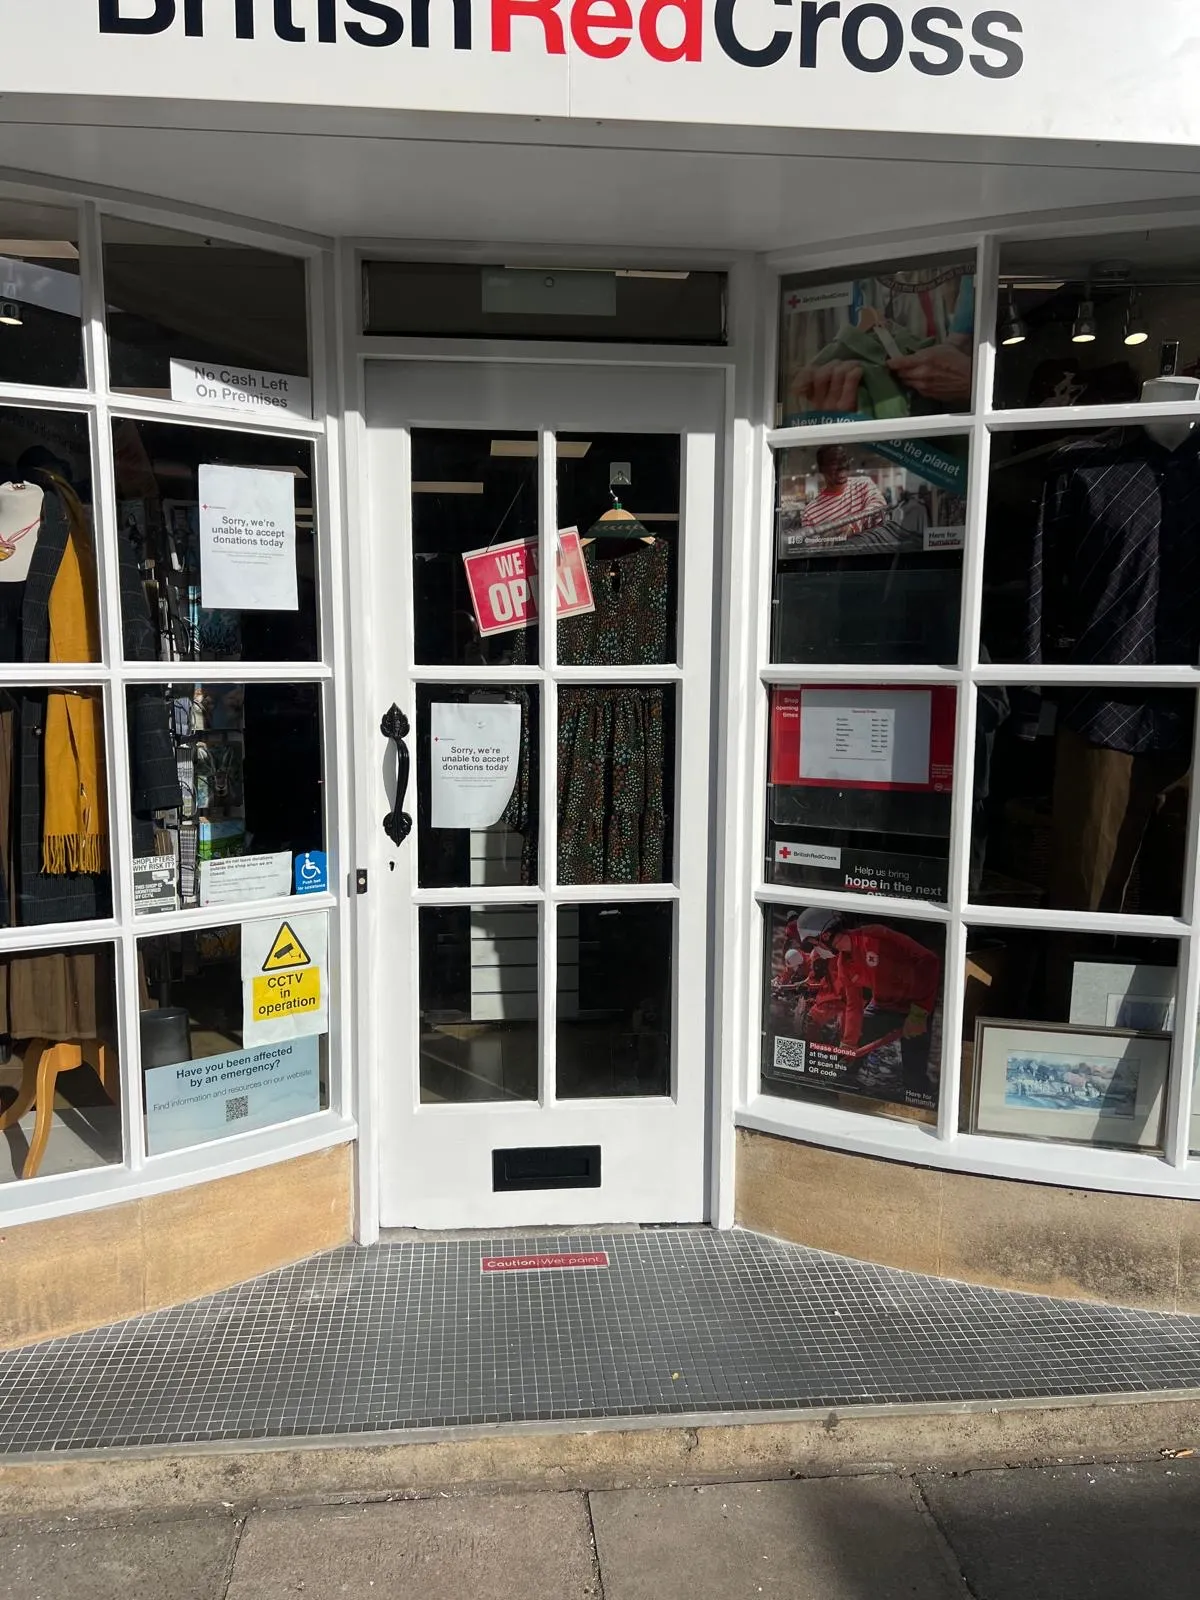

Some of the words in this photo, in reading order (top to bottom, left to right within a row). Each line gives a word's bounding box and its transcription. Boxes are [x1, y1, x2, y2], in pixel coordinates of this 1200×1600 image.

[194, 366, 215, 381] No
[220, 371, 256, 387] Cash
[262, 376, 288, 391] Left
[196, 384, 217, 398] On
[222, 387, 288, 408] Premises
[791, 417, 817, 428] New
[821, 416, 833, 424] to
[903, 442, 922, 458] the
[922, 454, 960, 477] planet
[222, 516, 249, 527] Sorry,
[251, 519, 275, 527] we're
[212, 526, 242, 535] unable
[256, 530, 285, 539] accept
[213, 536, 258, 545] donations
[260, 539, 284, 548] today
[495, 547, 538, 579] WE'
[451, 746, 476, 755] Sorry,
[482, 756, 509, 764] accept
[443, 763, 483, 771] donations
[486, 764, 508, 772] today
[133, 856, 174, 866] SHOPLIFTERS
[793, 851, 837, 861] BritishRedCross
[133, 864, 147, 872] WHY
[855, 866, 873, 876] Help
[876, 869, 886, 877] us
[888, 869, 909, 881] bring
[845, 875, 877, 889] hope
[880, 880, 890, 890] in
[893, 881, 911, 892] the
[916, 886, 942, 896] next
[268, 973, 303, 988] CCTV
[280, 988, 290, 998] in
[258, 997, 316, 1016] operation
[809, 1042, 831, 1052] Please
[833, 1047, 857, 1057] donate
[818, 1052, 828, 1060] the
[176, 1068, 202, 1079] Have
[205, 1063, 224, 1076] you
[226, 1055, 251, 1068] been
[253, 1046, 293, 1062] affected
[817, 1061, 834, 1069] scan
[835, 1063, 847, 1071] this
[190, 1078, 203, 1088] by
[205, 1075, 218, 1084] an
[220, 1059, 281, 1080] emergency?
[809, 1067, 819, 1075] QR
[821, 1069, 837, 1077] code
[153, 1101, 170, 1112] Find
[171, 1093, 212, 1108] information
[213, 1088, 227, 1098] and
[228, 1081, 262, 1093] resources
[263, 1078, 273, 1087] on
[273, 1076, 285, 1084] our
[905, 1090, 921, 1098] Here
[569, 1256, 601, 1265] paint
